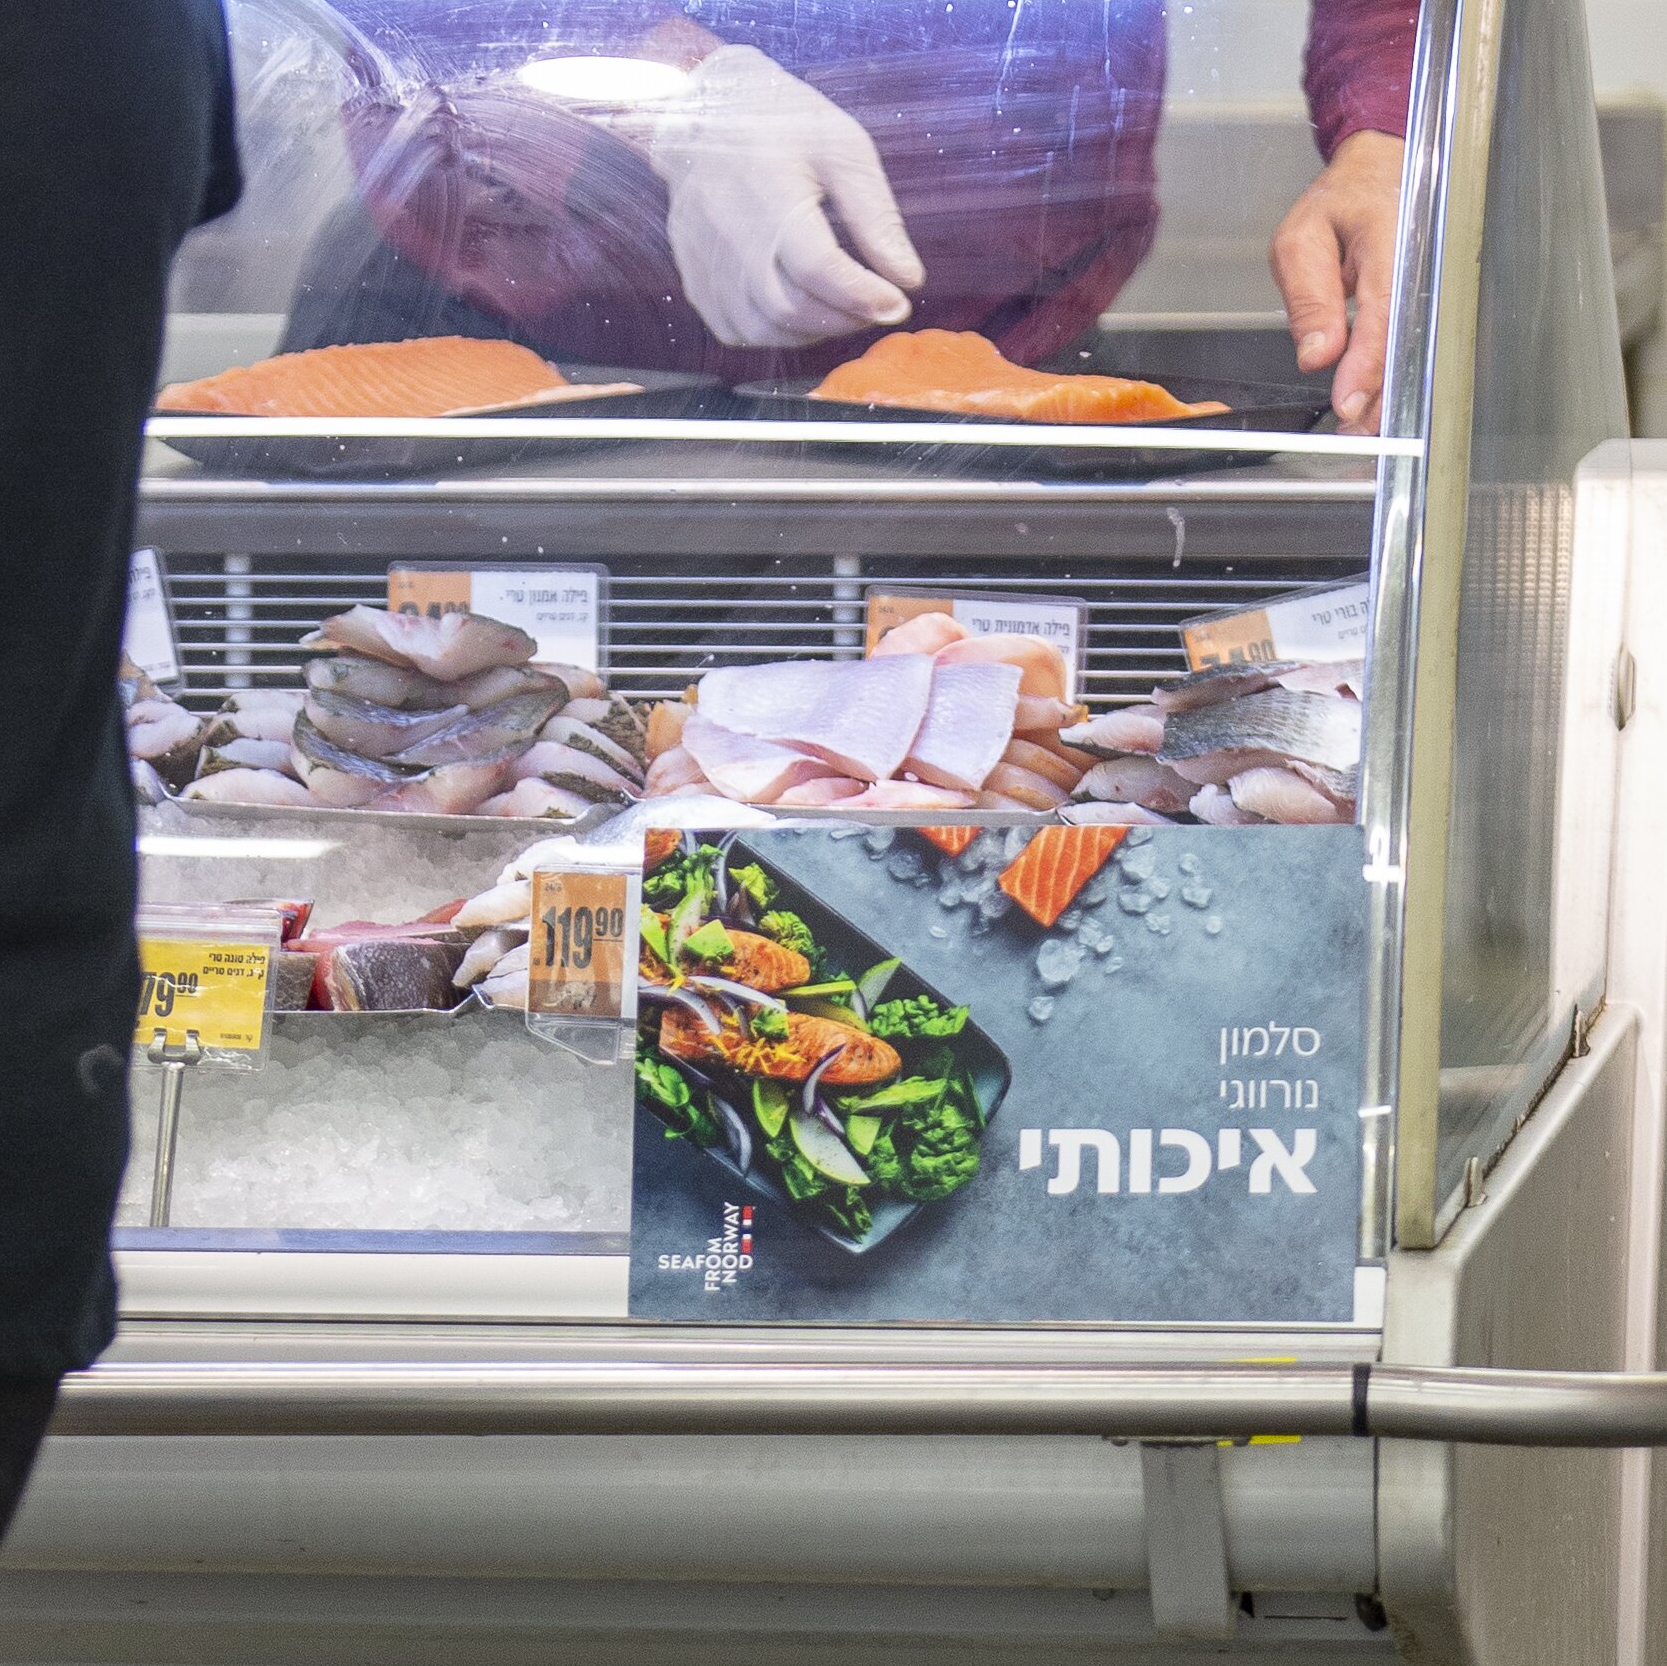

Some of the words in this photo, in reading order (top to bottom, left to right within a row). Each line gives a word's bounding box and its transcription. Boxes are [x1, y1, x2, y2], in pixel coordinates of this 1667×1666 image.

[972, 618, 990, 632] טרי
[1044, 619, 1070, 636] פילה
[1312, 610, 1332, 625] טרי
[542, 906, 593, 969] 119
[1220, 1021, 1321, 1065] סלמון
[1220, 1080, 1320, 1109] נורווגי
[1019, 1128, 1319, 1194] איכותי
[722, 1201, 740, 1284] NORWAY
[658, 1254, 754, 1269] SEAFOOD
[704, 1237, 722, 1291] FROM
